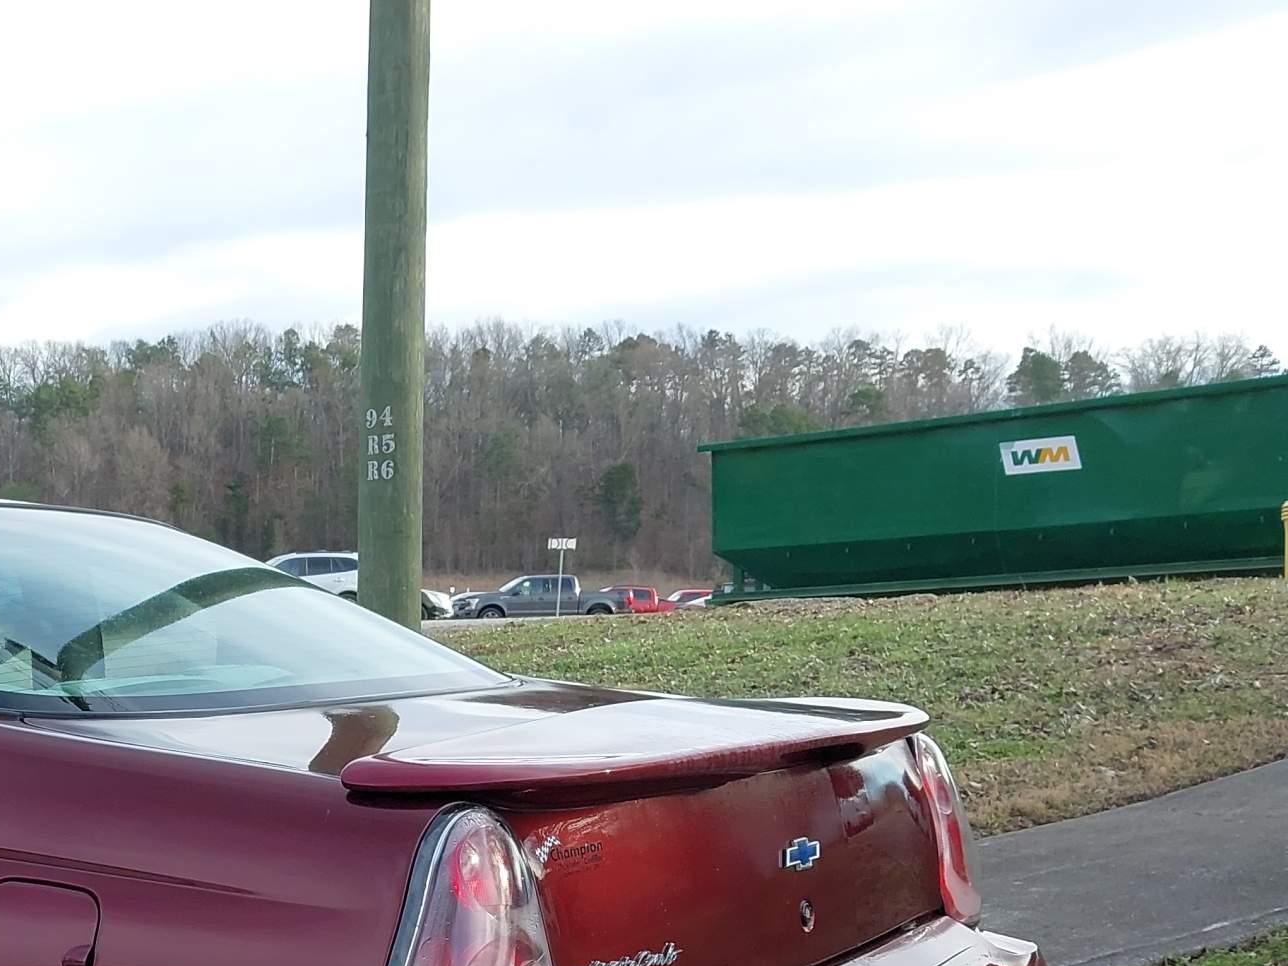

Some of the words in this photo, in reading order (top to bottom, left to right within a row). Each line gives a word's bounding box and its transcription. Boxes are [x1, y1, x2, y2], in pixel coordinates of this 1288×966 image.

[366, 405, 393, 429] 94
[367, 433, 396, 455] R5
[1011, 446, 1071, 466] WM
[367, 460, 394, 481] R6
[550, 841, 603, 861] Champion
